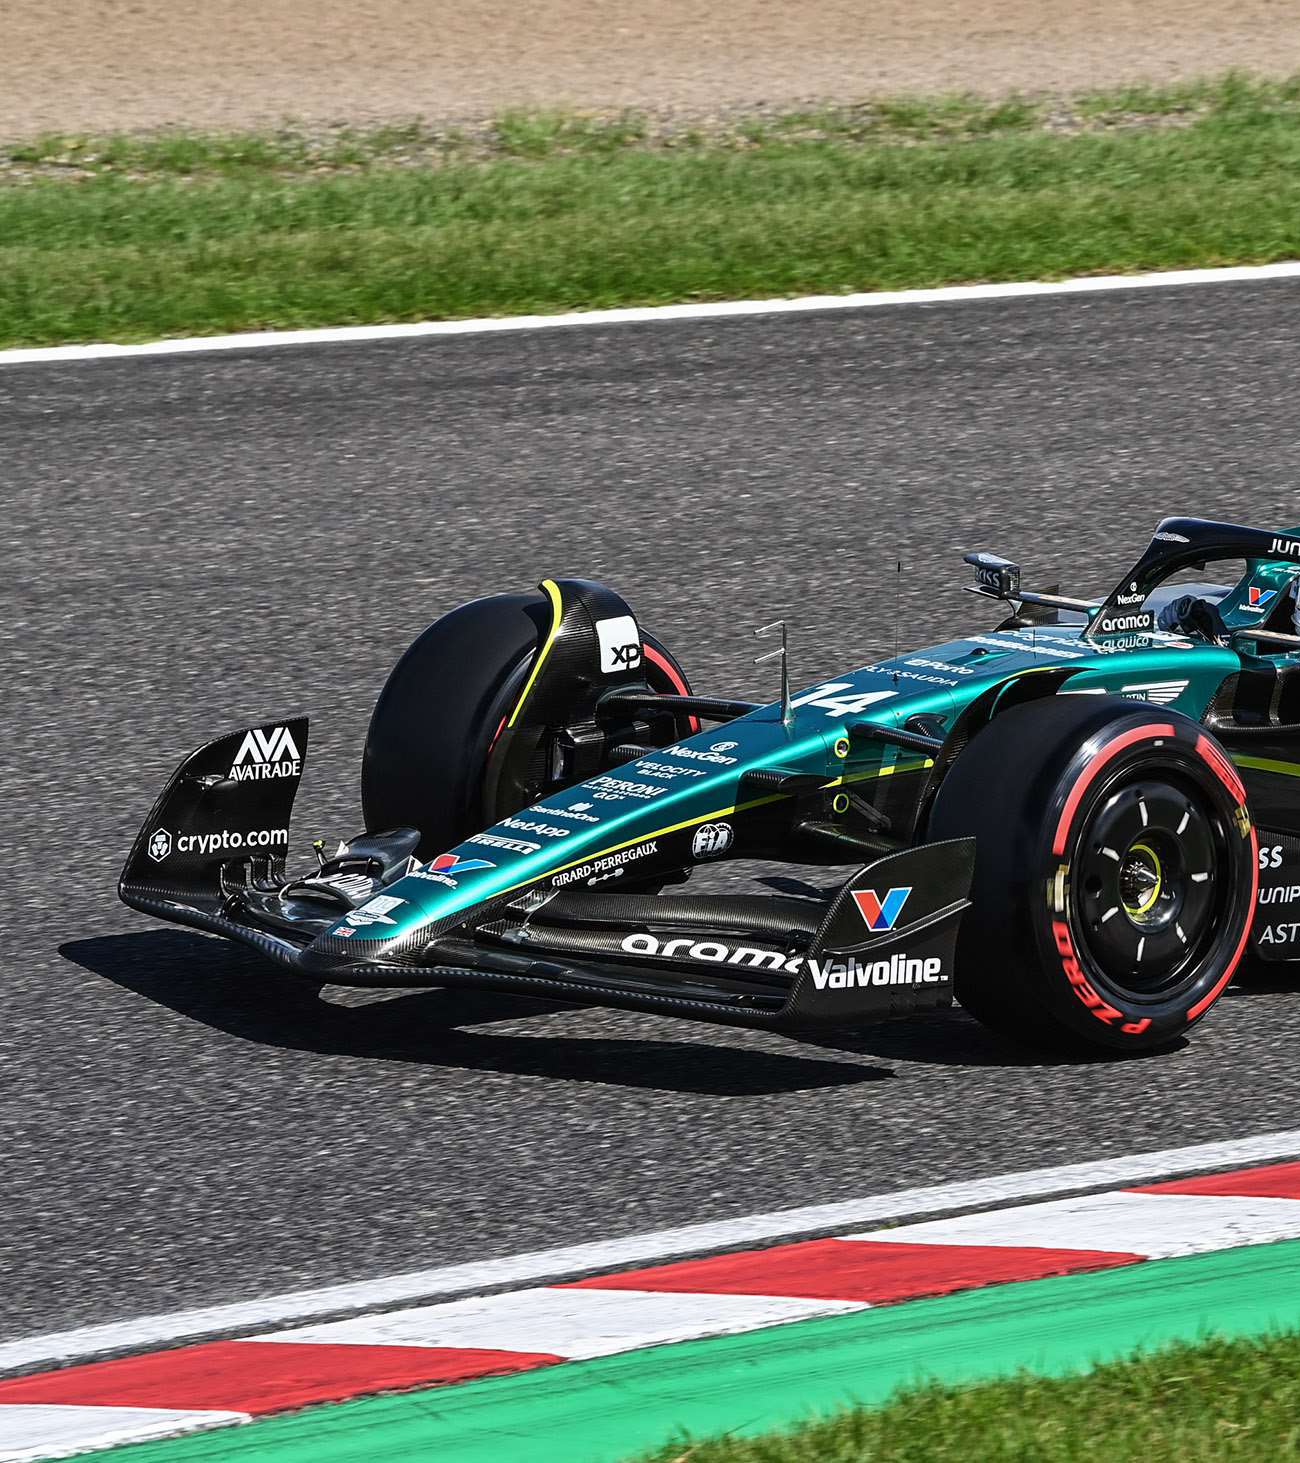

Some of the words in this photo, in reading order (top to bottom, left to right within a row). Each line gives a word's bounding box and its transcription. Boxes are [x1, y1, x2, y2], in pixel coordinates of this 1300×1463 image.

[1117, 593, 1145, 605] NexGen
[1102, 614, 1150, 631] aramco
[789, 682, 900, 718] 14
[662, 745, 739, 766] NexGen
[228, 759, 301, 782] AVATRADE
[635, 760, 708, 777] VELOCITY
[637, 769, 678, 780] BLACK
[588, 776, 669, 797] PERONI
[496, 817, 571, 838] NetApp
[177, 829, 288, 854] crypto.com
[551, 841, 659, 887] GIRARD-PERREGAUX
[1052, 920, 1124, 1025] ZERO
